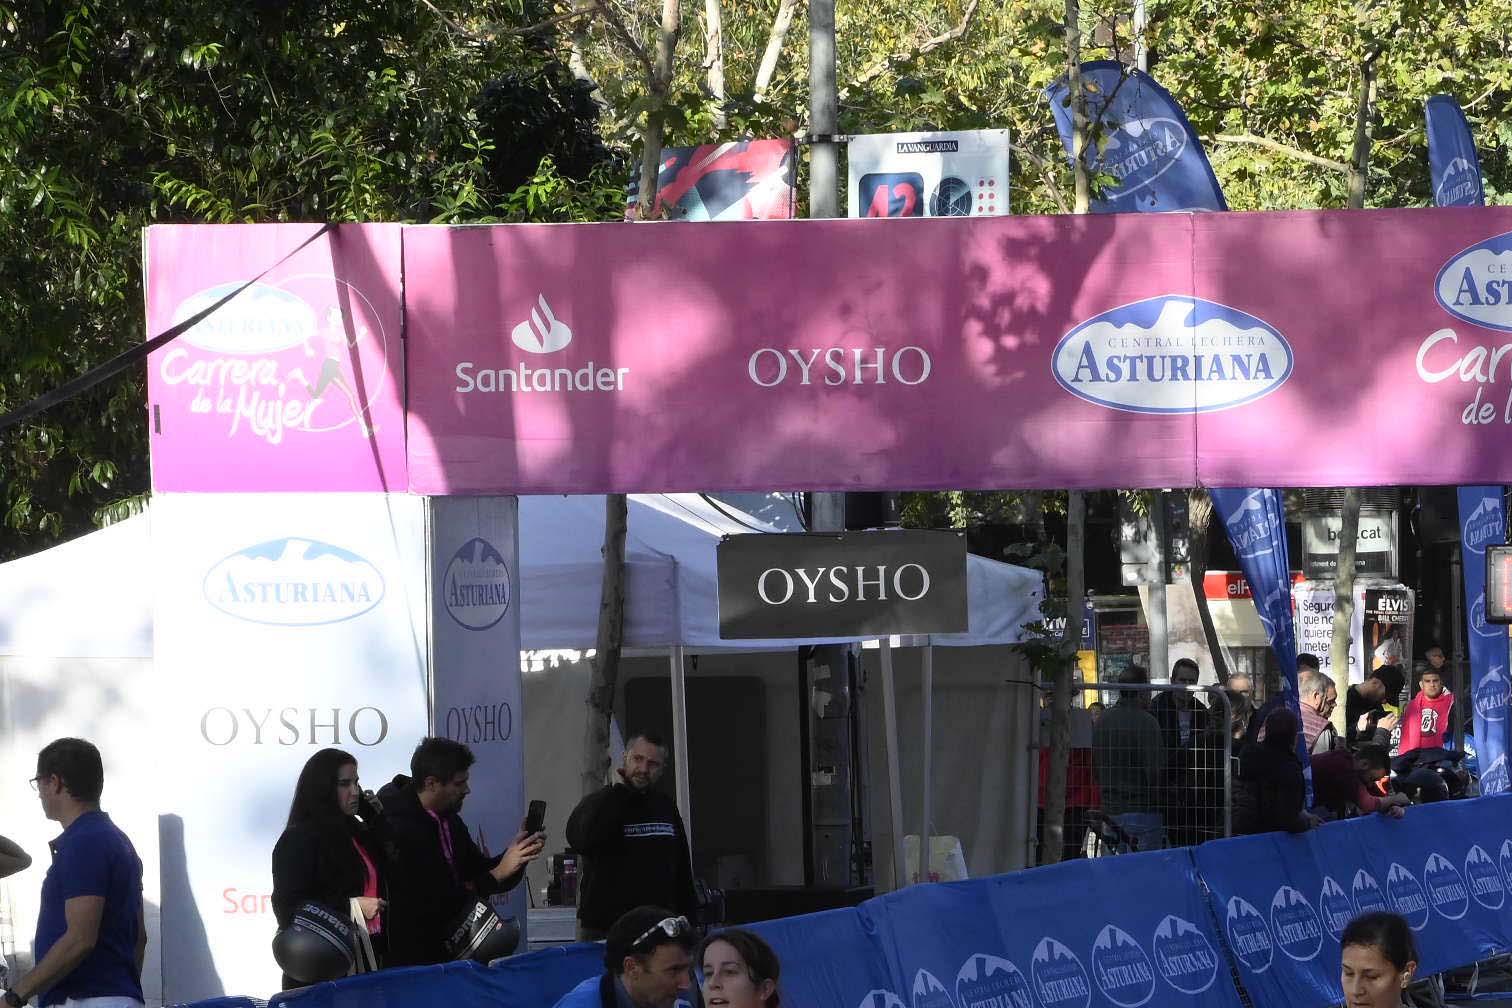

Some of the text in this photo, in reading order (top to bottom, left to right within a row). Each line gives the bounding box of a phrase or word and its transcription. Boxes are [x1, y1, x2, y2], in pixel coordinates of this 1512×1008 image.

[160, 347, 283, 386] Carrera
[455, 361, 631, 394] Santander
[748, 346, 932, 387] OYSHO
[1071, 339, 1275, 383] ASTURIANA
[228, 383, 324, 445] Mujer
[1462, 387, 1496, 426] de
[449, 577, 507, 608] ASTURIANA
[757, 562, 931, 605] OYSHO
[200, 706, 389, 747] OYSHO
[445, 701, 513, 744] OYSHO
